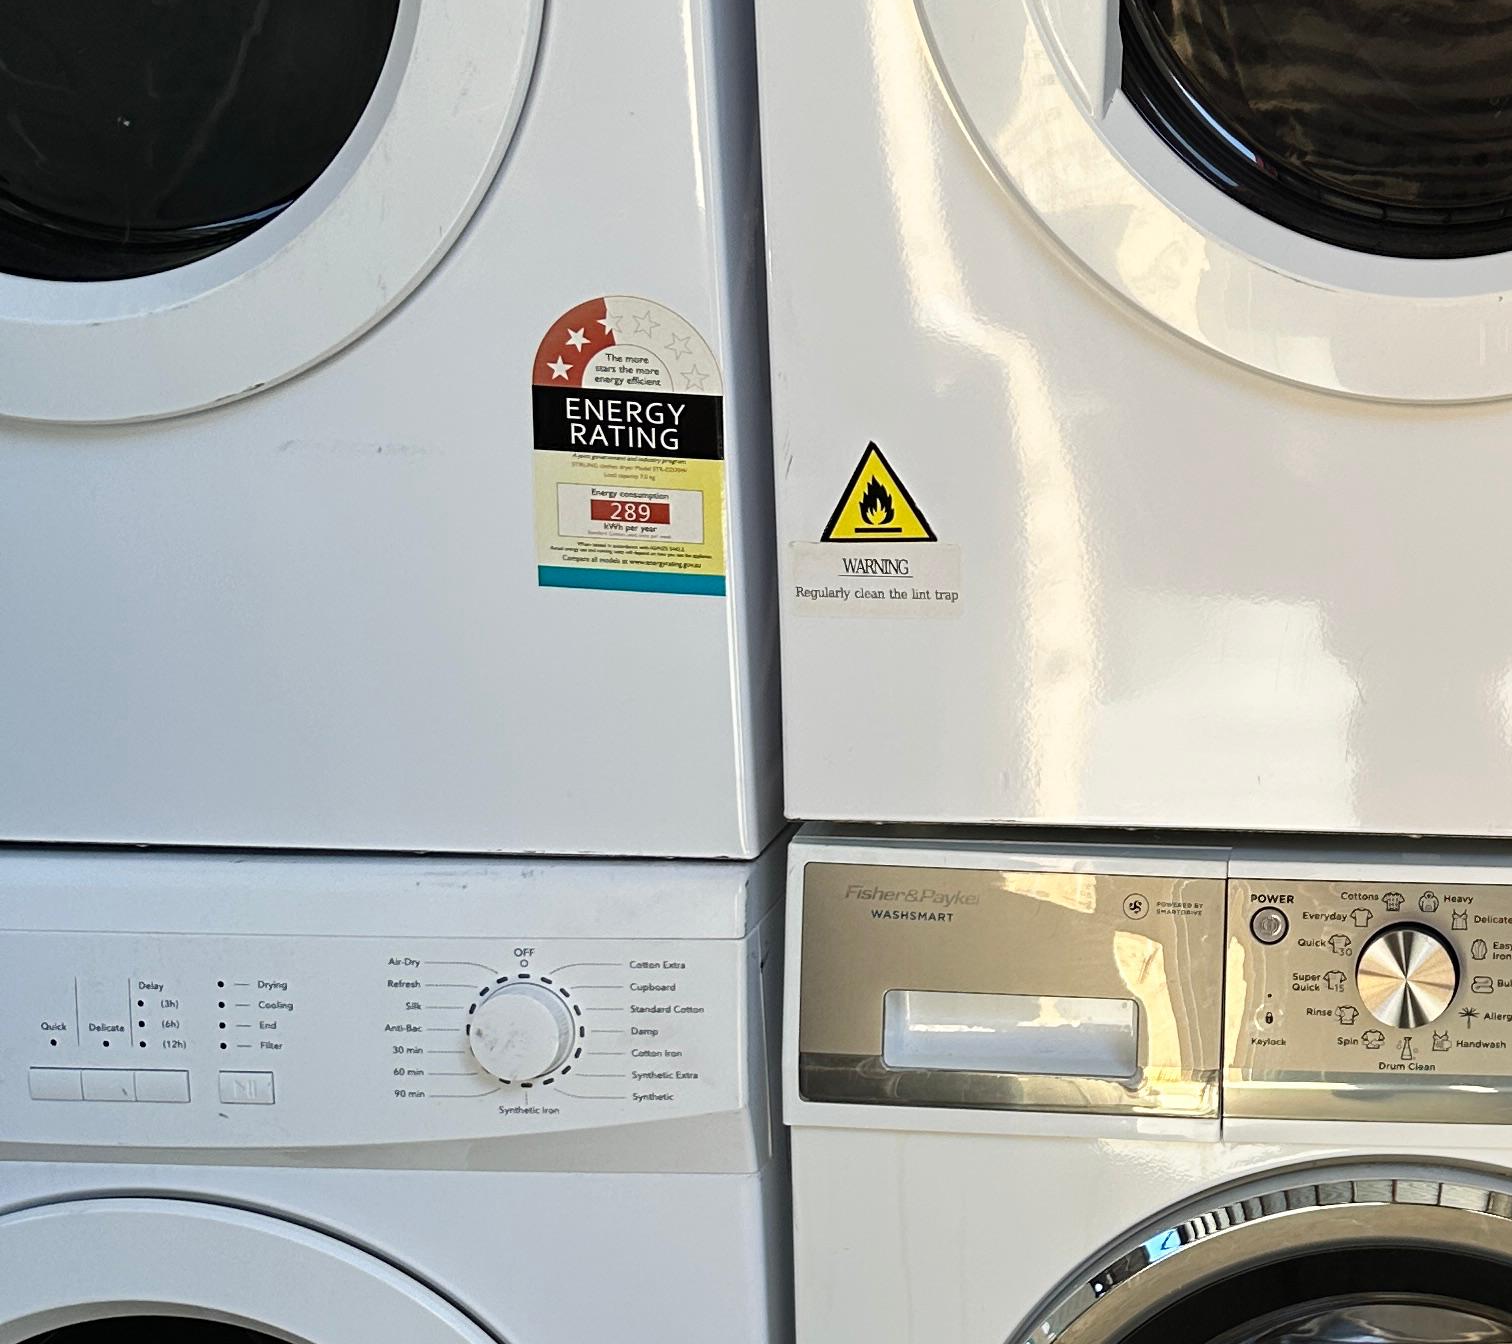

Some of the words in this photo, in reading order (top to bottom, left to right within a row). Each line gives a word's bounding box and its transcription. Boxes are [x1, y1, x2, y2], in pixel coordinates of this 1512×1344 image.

[566, 398, 684, 426] ENERGY
[570, 423, 678, 450] RATING
[610, 502, 650, 521] 289
[843, 558, 908, 574] WARNING
[796, 587, 850, 600] Regularly
[855, 588, 885, 599] clean
[890, 588, 907, 599] the
[912, 589, 931, 599] lint
[935, 590, 958, 603] trap
[1251, 894, 1294, 903] POWER
[1341, 892, 1379, 900] Cottons
[1444, 896, 1473, 904] Heavy
[871, 910, 953, 921] WASHSMART
[1303, 912, 1347, 922] Everyday
[1474, 915, 1512, 924] Delicate
[514, 948, 534, 957] OFF
[1493, 950, 1512, 960] Iron
[1292, 973, 1320, 983] Super
[630, 983, 676, 992] Cupboard
[1292, 981, 1320, 991] Quick
[1307, 1008, 1332, 1016] Rinse
[163, 1040, 187, 1049] (12h)
[1252, 1038, 1286, 1046] Keylock
[1338, 1037, 1358, 1046] Spin
[1457, 1040, 1506, 1048] Handwash
[1379, 1062, 1405, 1070] Drum
[1408, 1063, 1435, 1071] Clean
